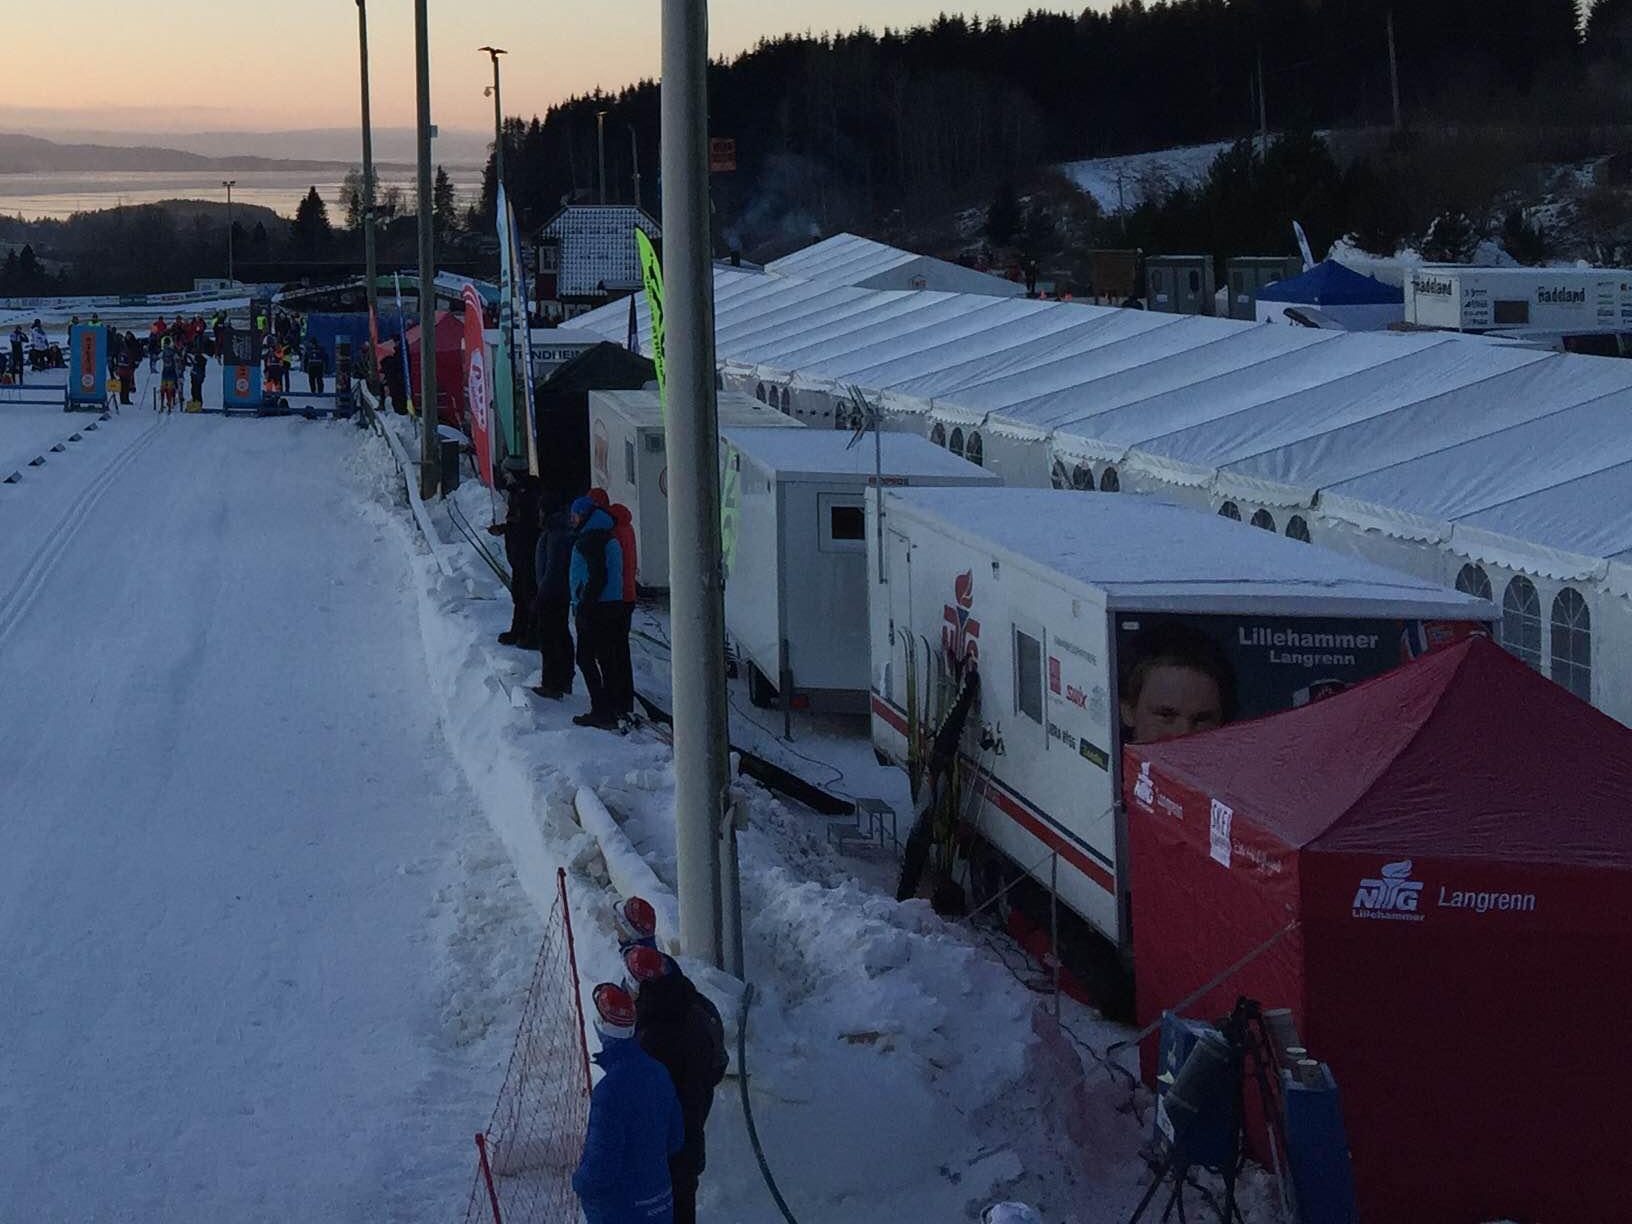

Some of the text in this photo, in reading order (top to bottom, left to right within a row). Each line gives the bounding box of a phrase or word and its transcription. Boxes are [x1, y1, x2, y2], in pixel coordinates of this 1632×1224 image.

[1238, 626, 1378, 649] Lillehammer
[1269, 650, 1356, 667] Langrenn
[1437, 886, 1537, 913] Langrenn
[1351, 908, 1425, 921] Lillehammer
